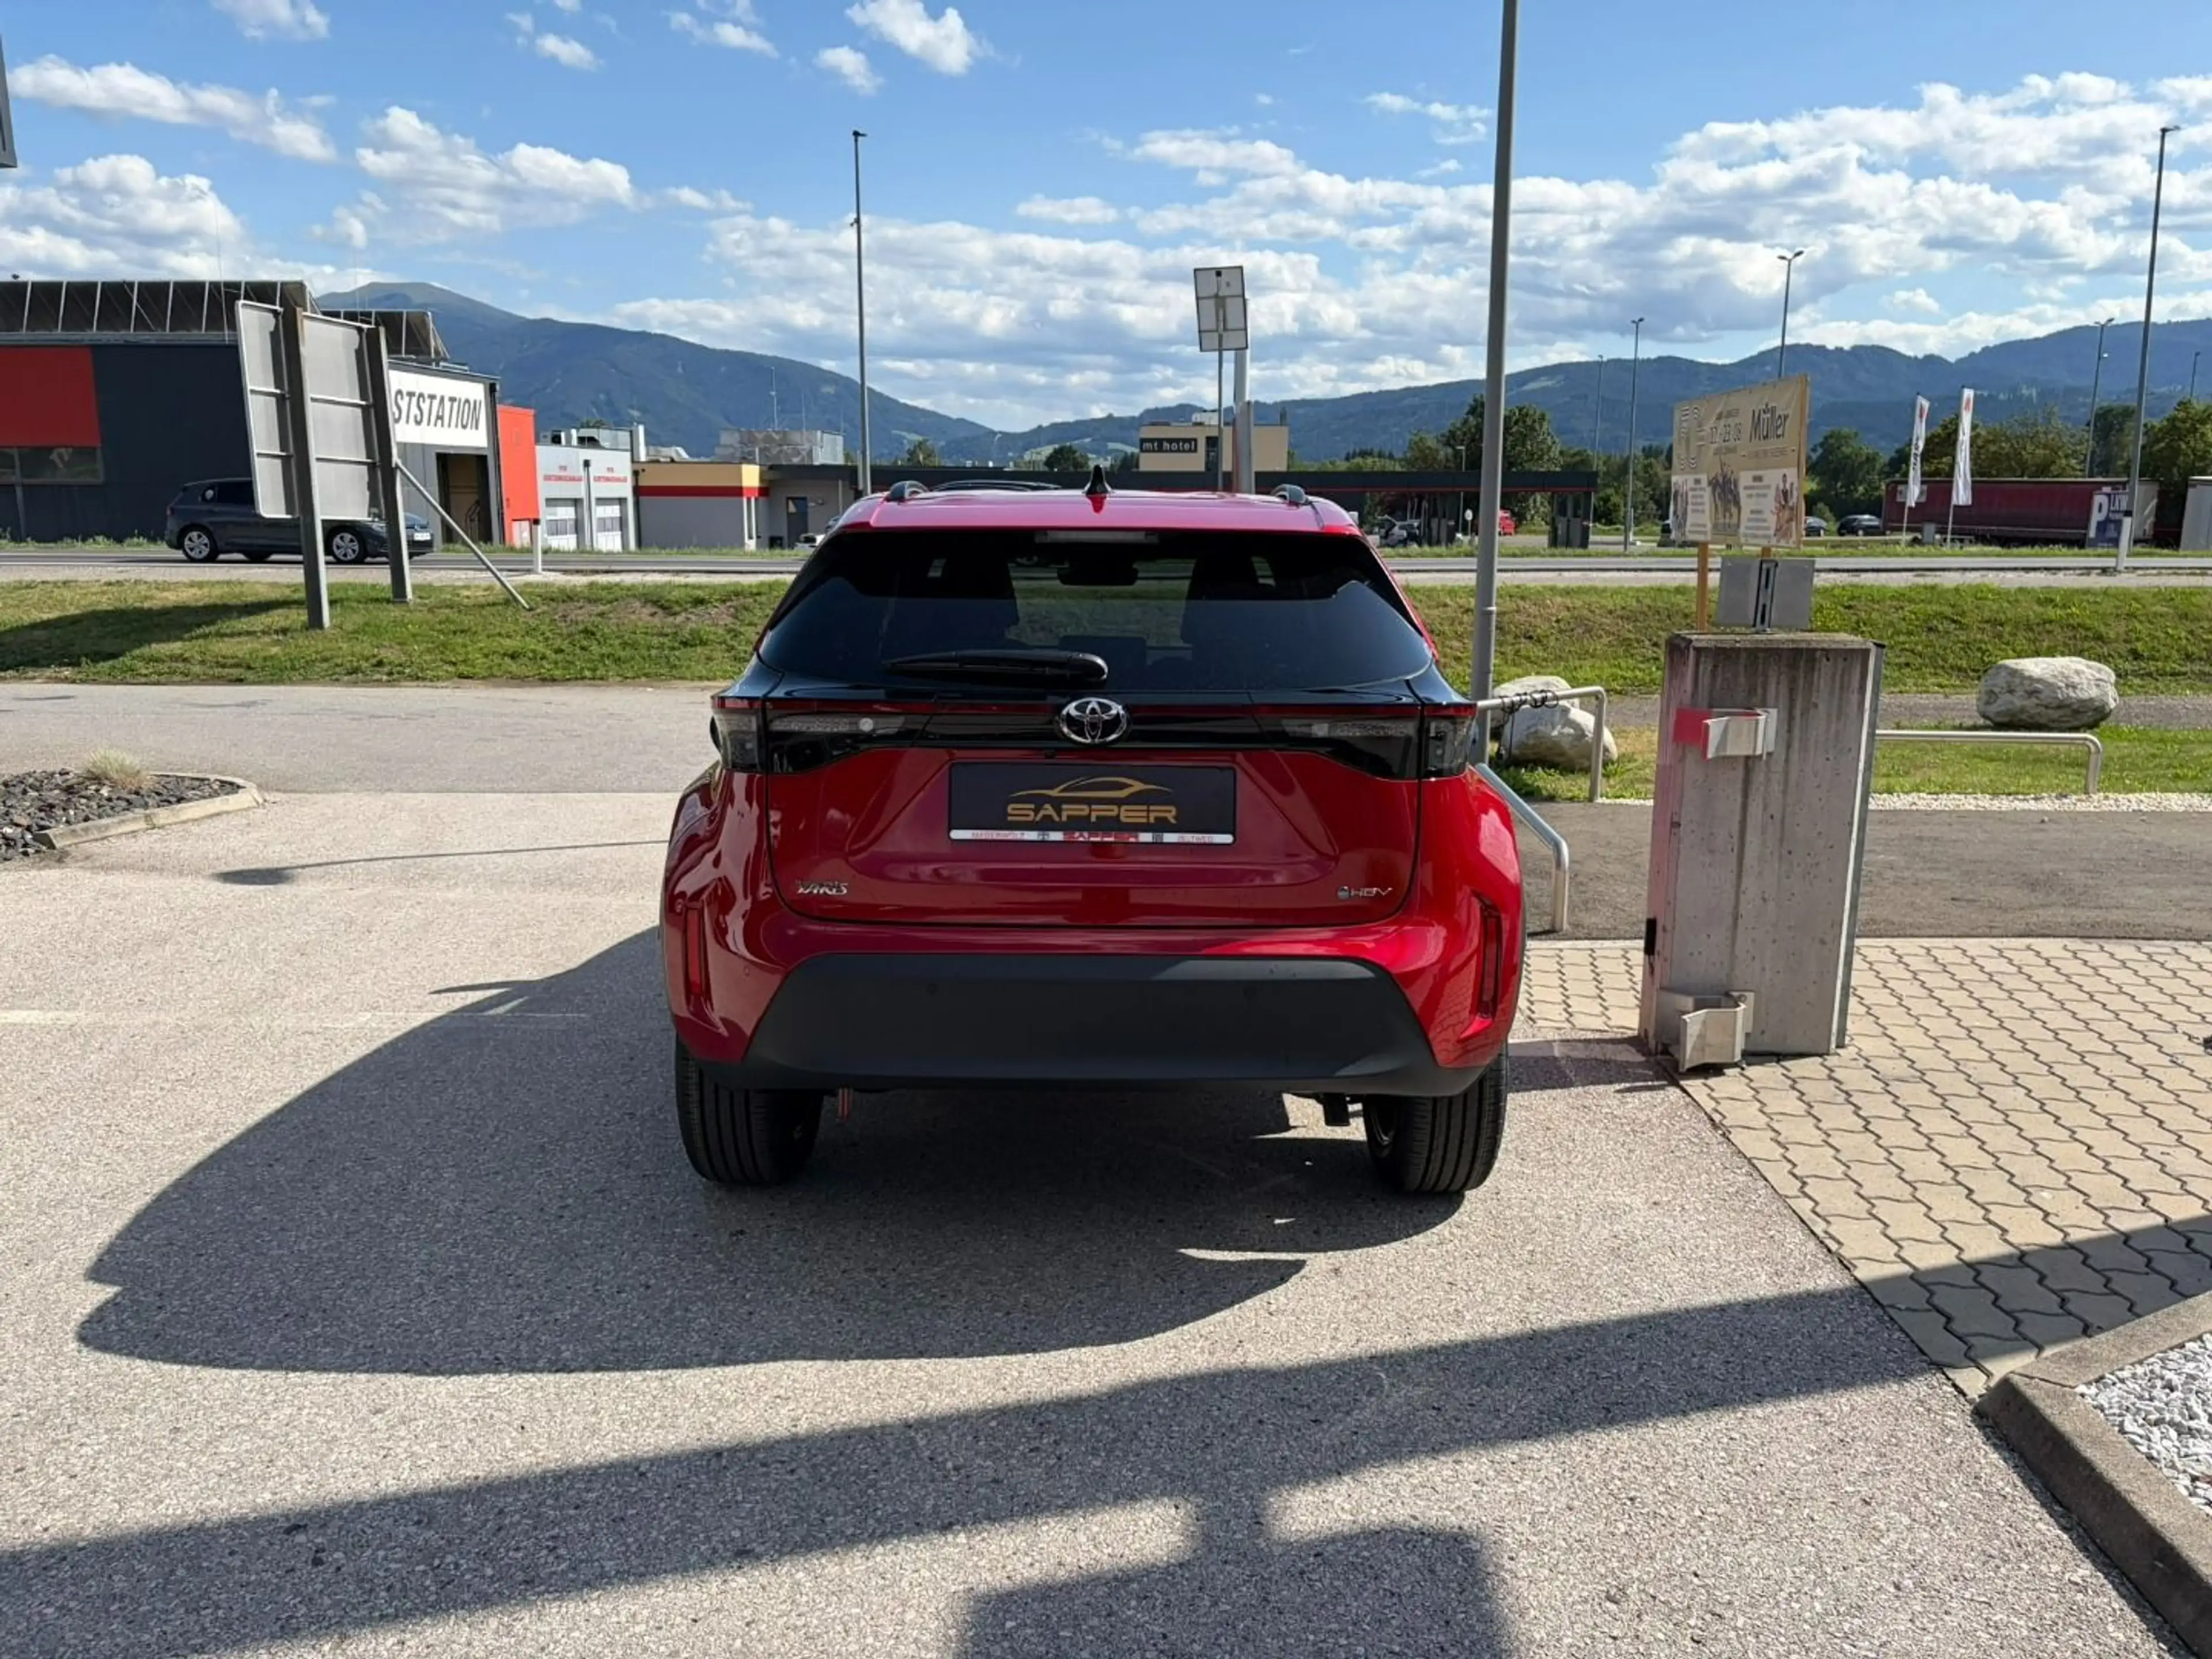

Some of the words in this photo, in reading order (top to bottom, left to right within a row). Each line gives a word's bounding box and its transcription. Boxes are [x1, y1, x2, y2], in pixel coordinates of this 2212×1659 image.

[393, 388, 482, 431] STSTATION
[1749, 402, 1789, 443] Müller
[1162, 440, 1195, 452] hotel
[1007, 803, 1177, 824] SAPPER
